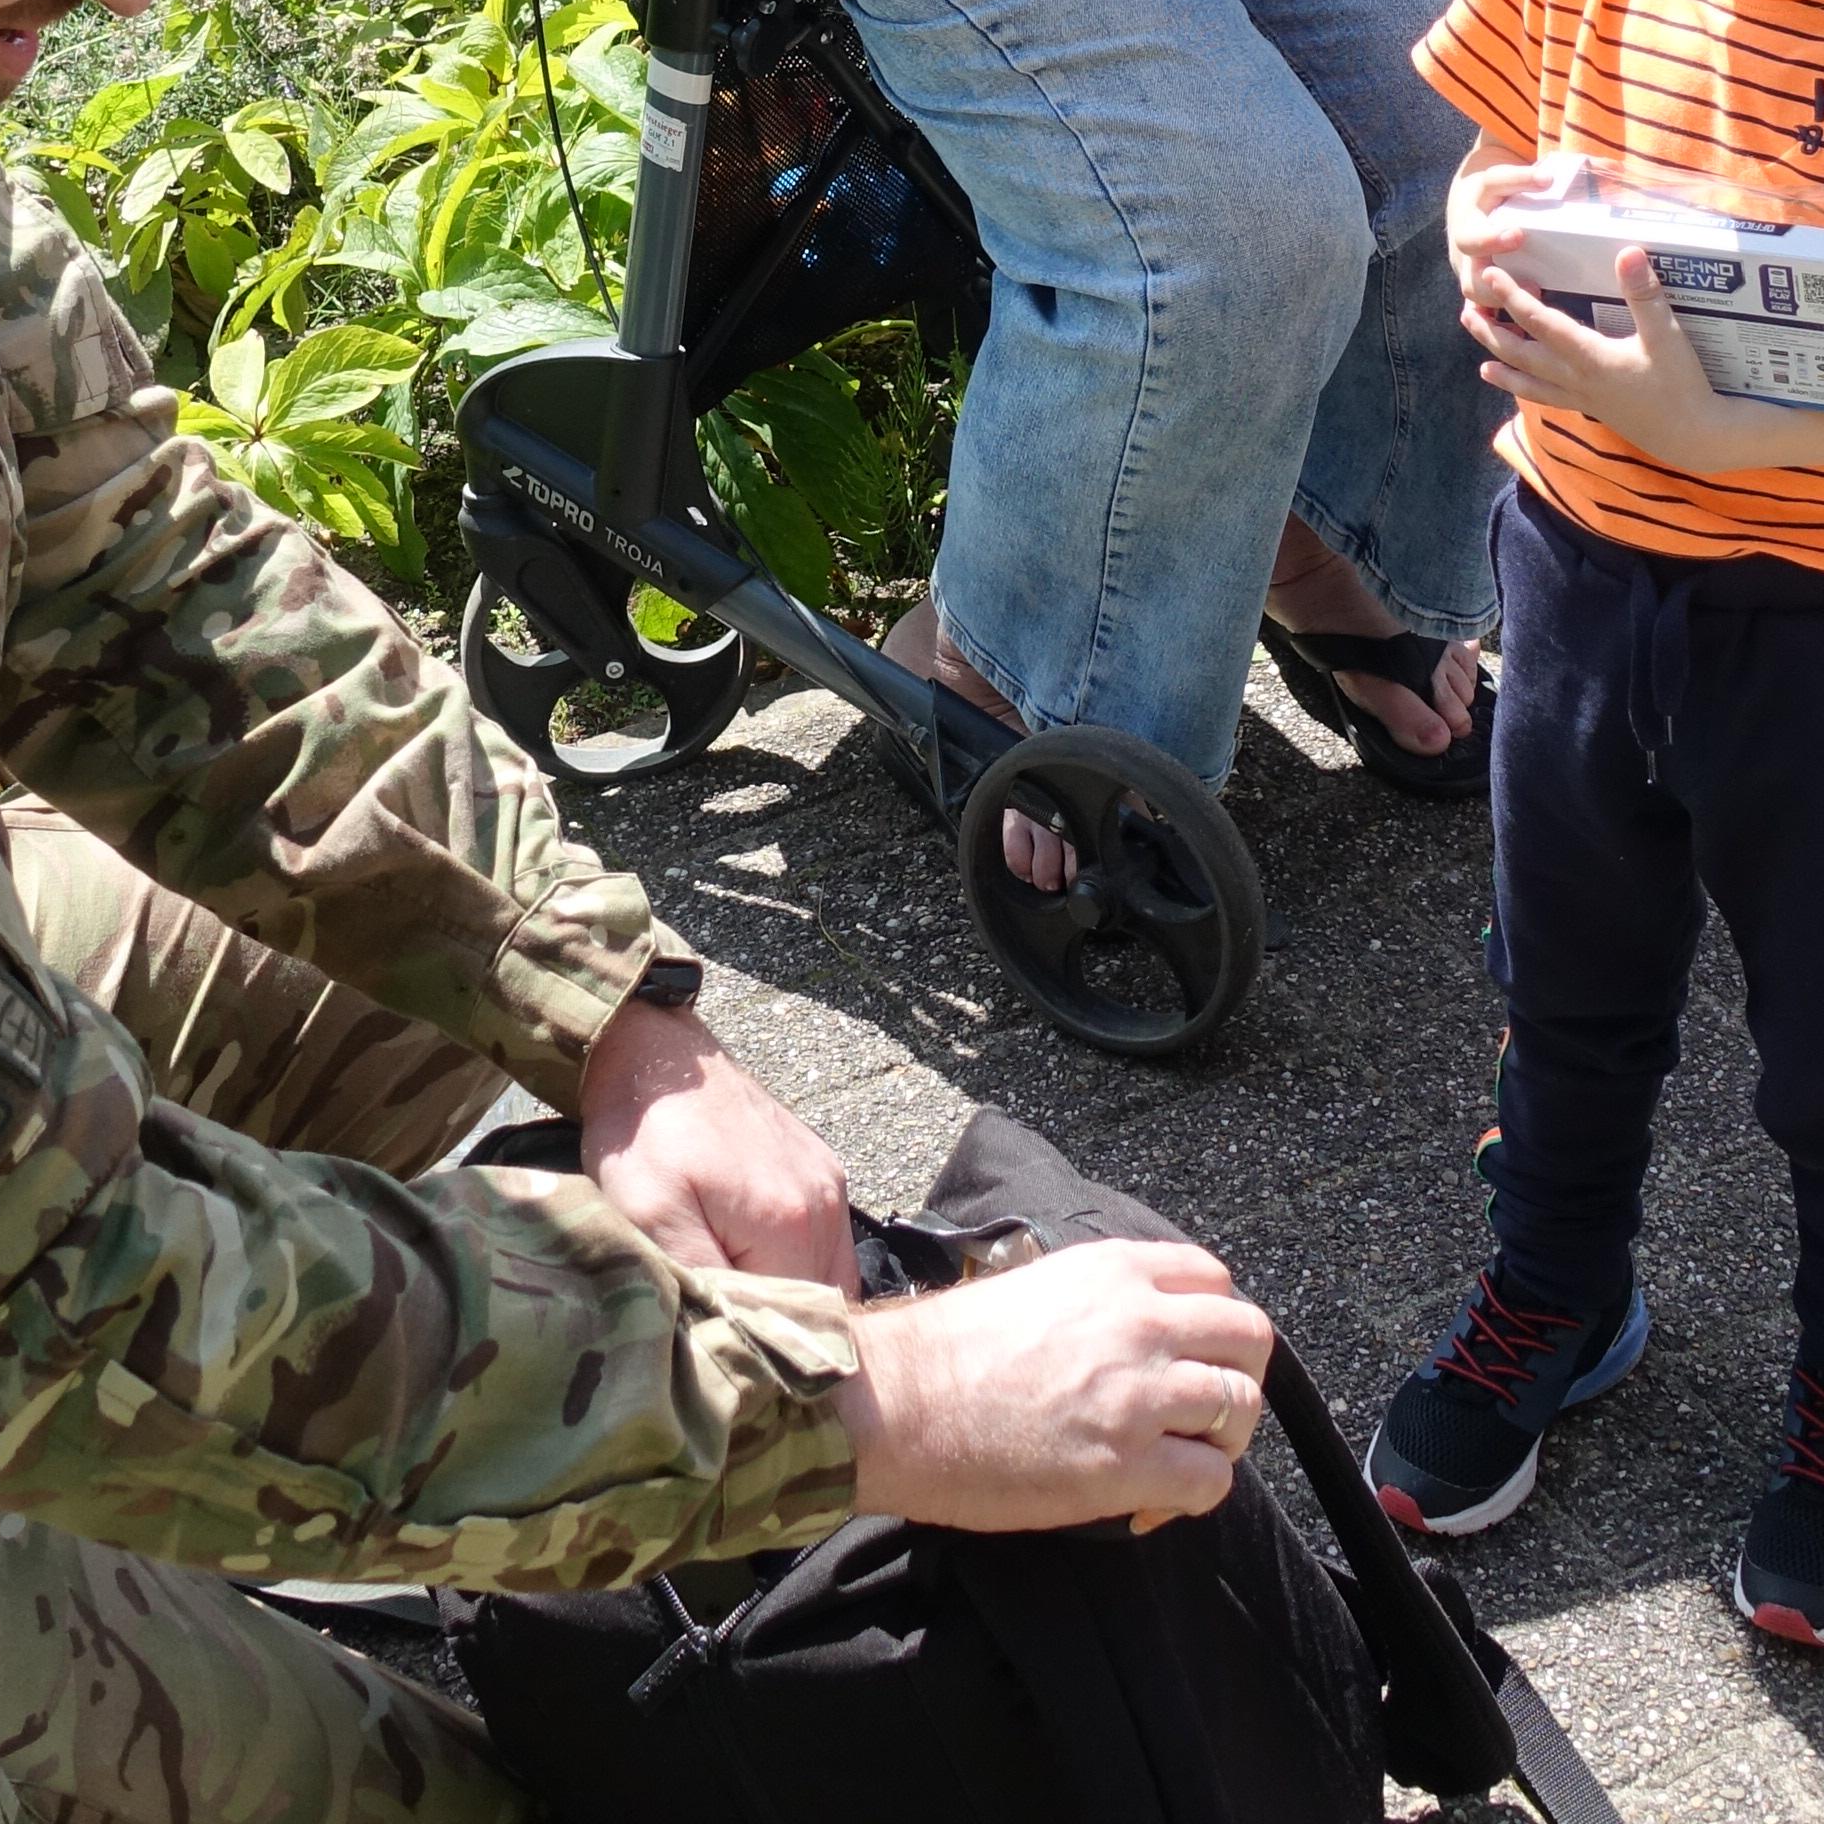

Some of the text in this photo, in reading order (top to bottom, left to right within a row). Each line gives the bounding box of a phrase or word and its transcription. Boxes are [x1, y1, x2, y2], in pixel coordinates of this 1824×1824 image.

[1647, 255, 1735, 277] TECHNO
[1656, 270, 1729, 290] DRIVE
[526, 474, 664, 578] TOPRO TROJA
